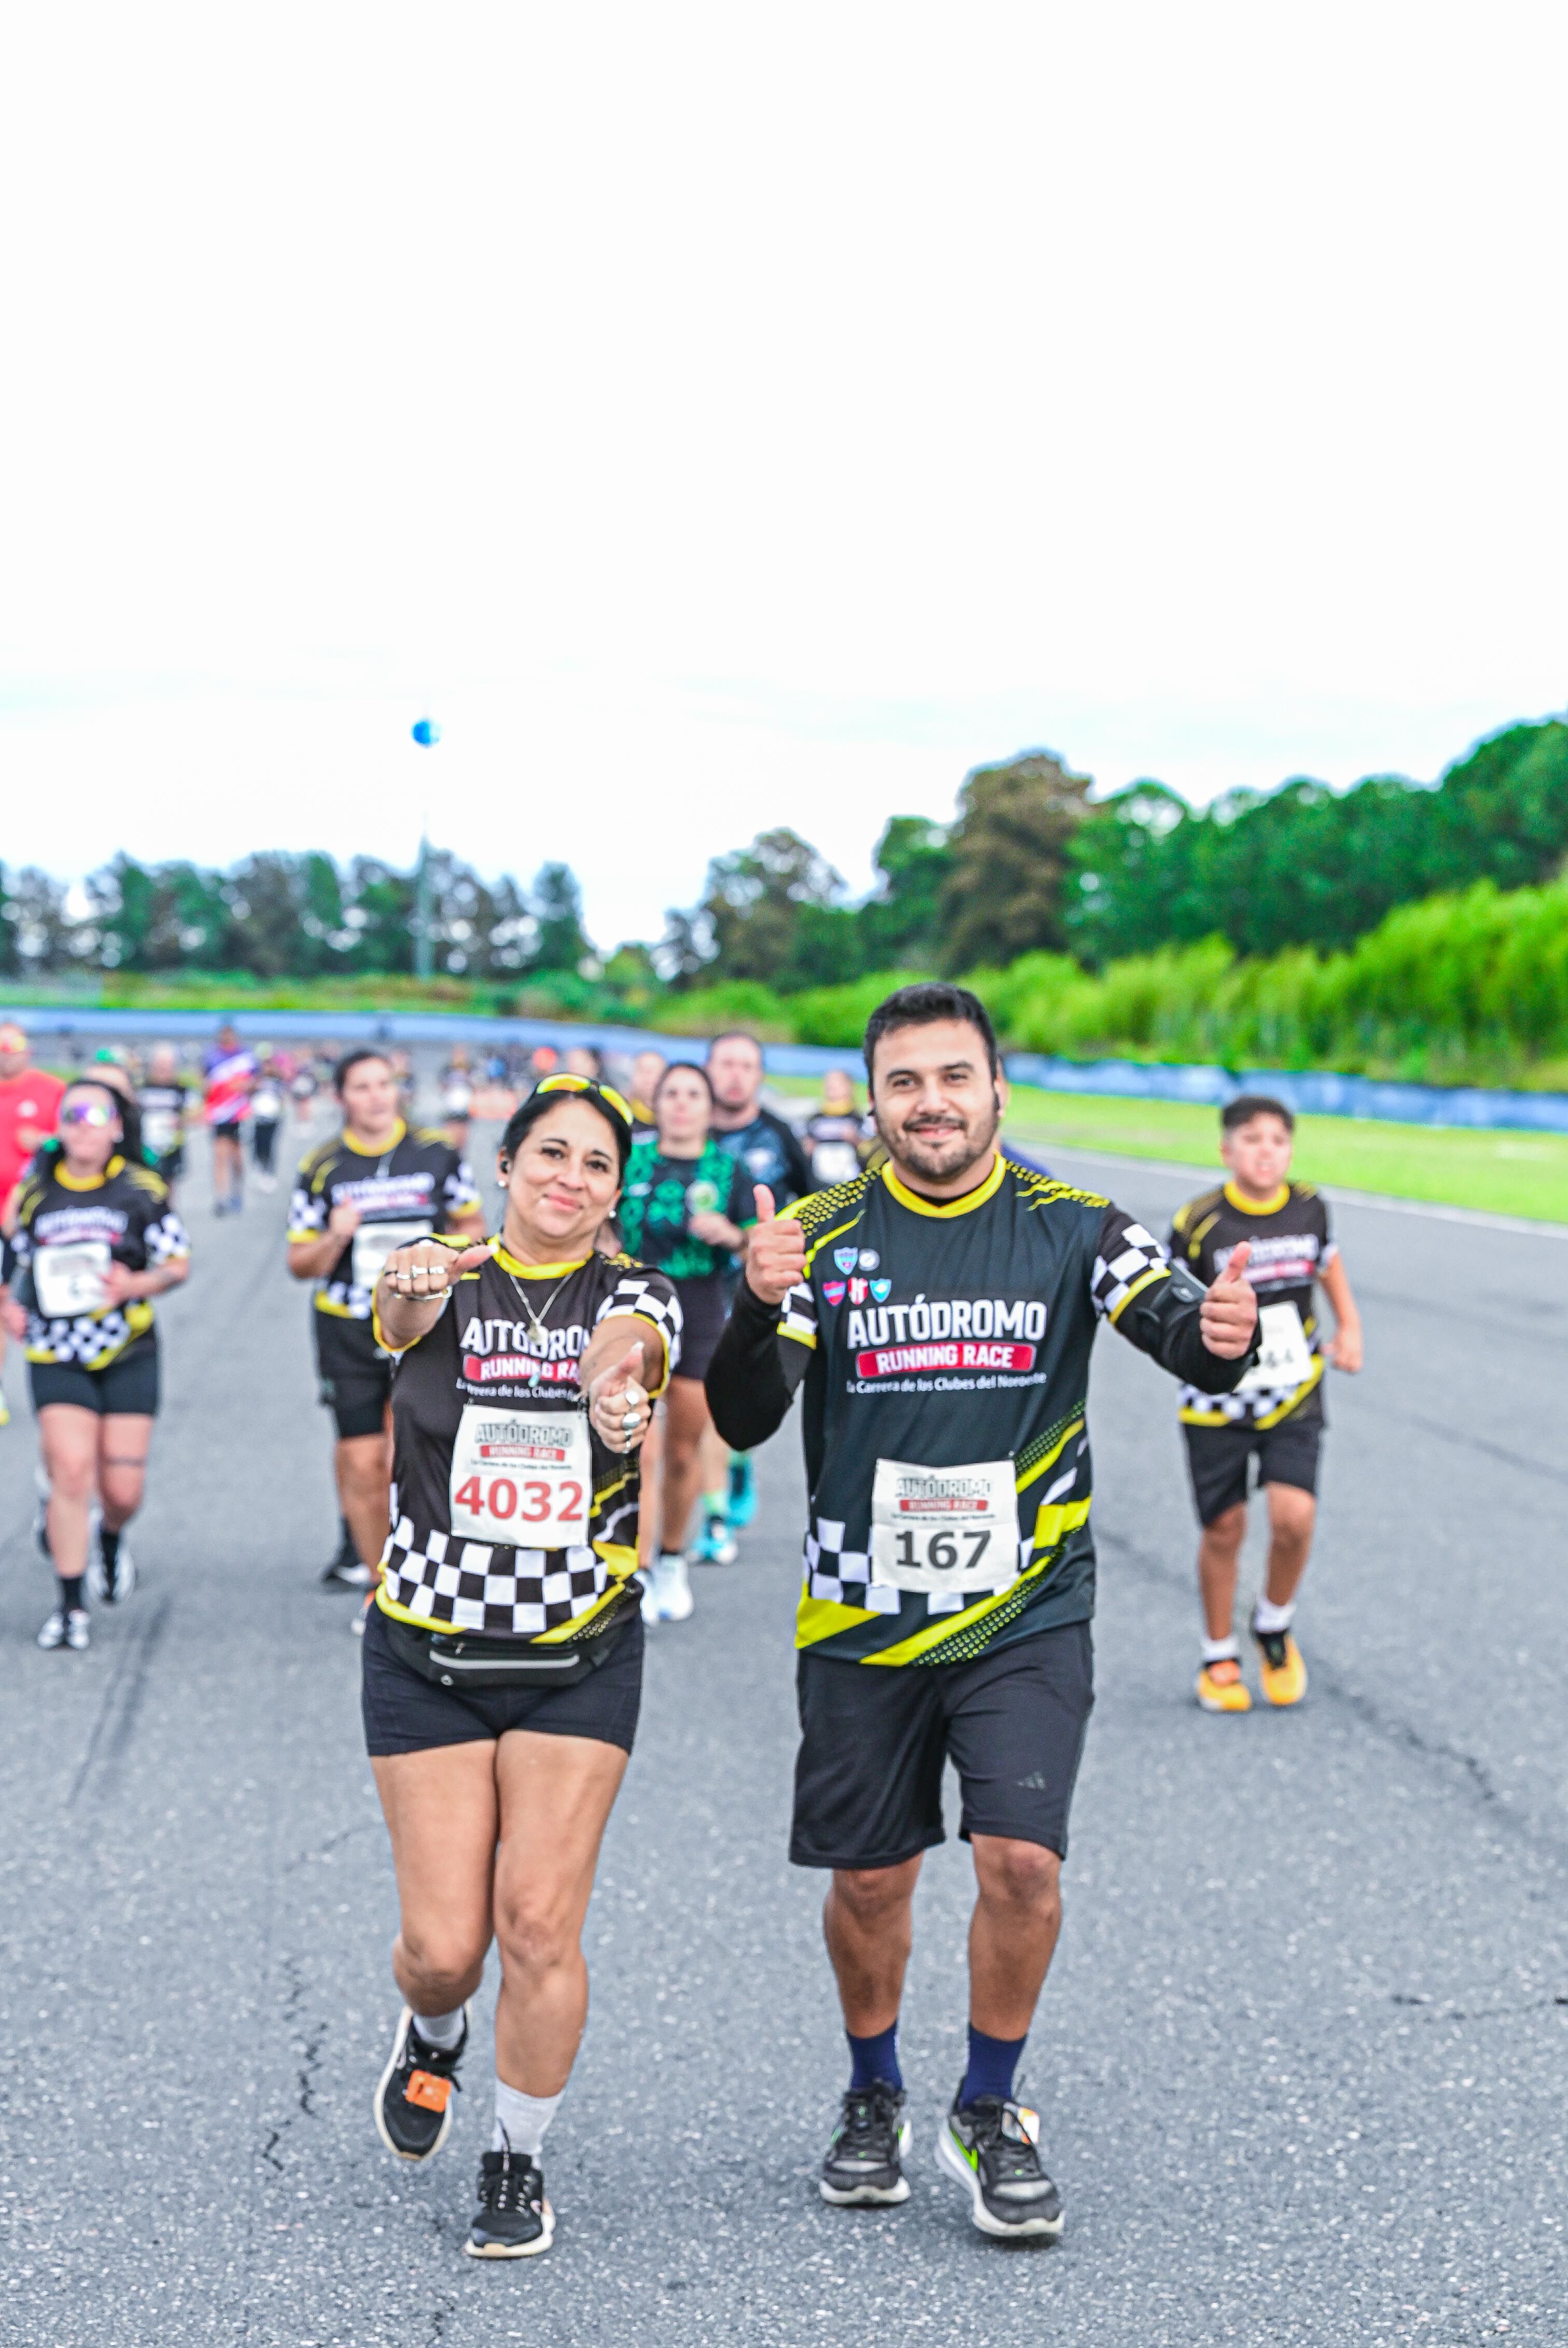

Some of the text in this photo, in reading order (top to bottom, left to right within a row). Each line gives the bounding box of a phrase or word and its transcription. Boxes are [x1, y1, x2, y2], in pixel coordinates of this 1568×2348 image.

[459, 1317, 591, 1361] AUTÓDRO
[847, 1293, 1047, 1349] AUTÓDROMO
[557, 1361, 582, 1385] RA
[875, 1344, 1015, 1374] RUNNING RACE
[474, 1418, 573, 1447] AUTÓDROMO
[455, 1475, 583, 1521] 4032
[895, 1530, 991, 1569] 167
